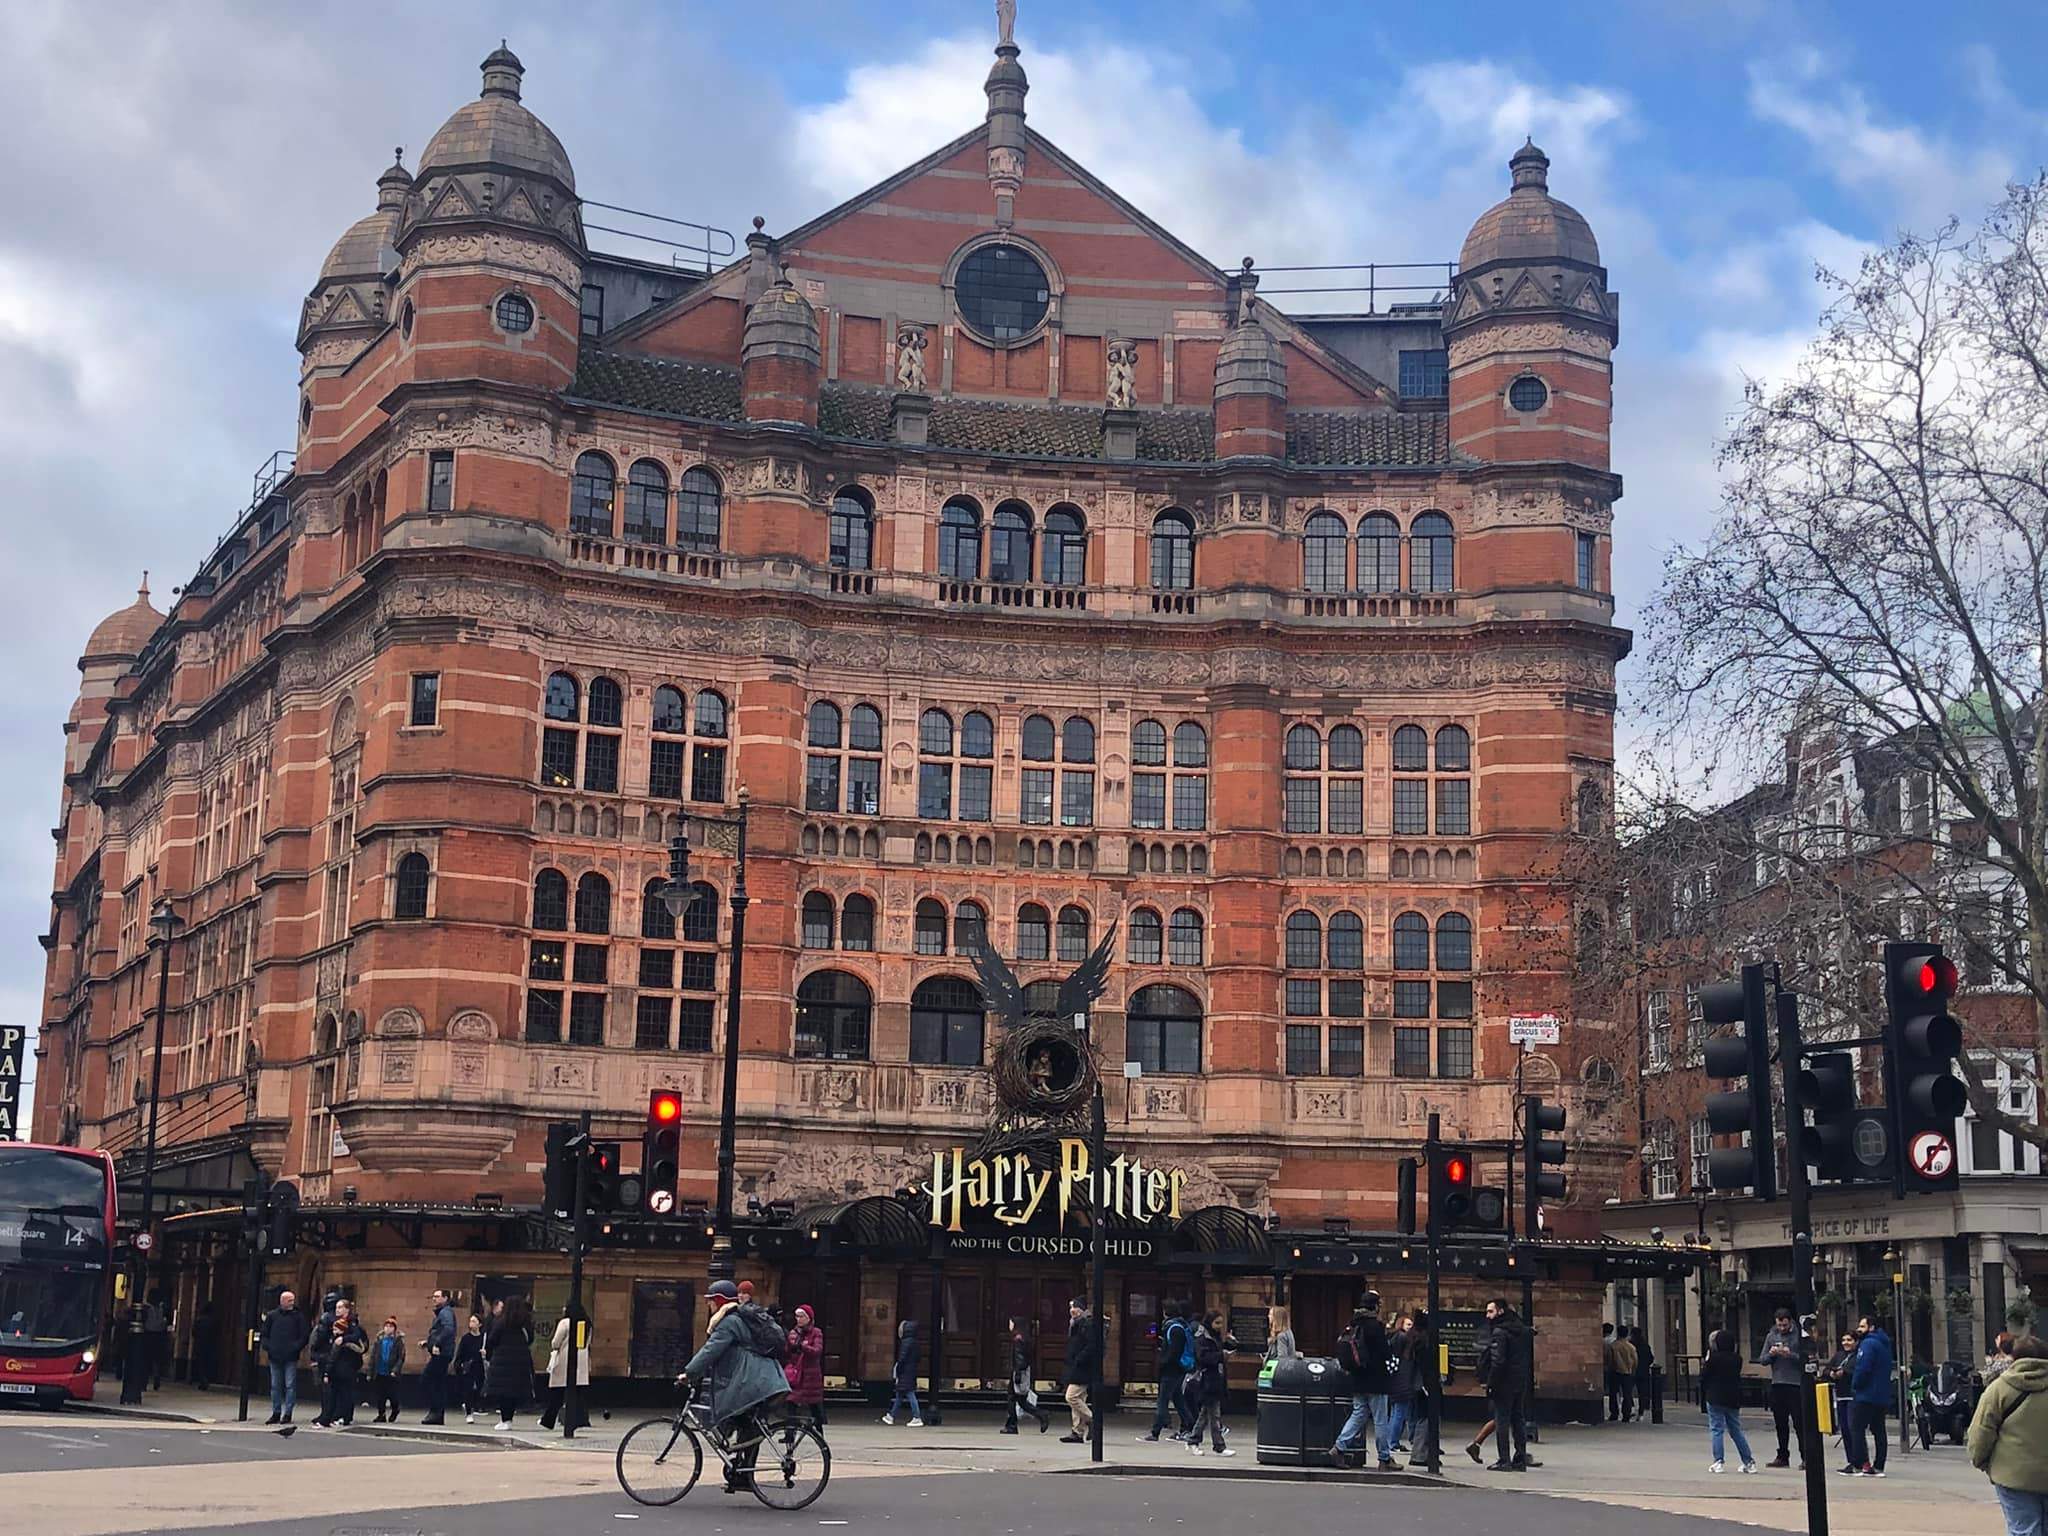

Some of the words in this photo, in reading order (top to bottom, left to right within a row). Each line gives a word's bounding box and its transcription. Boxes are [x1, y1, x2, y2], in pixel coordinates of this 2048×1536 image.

[1513, 1028, 1539, 1036] CIRCUS
[921, 1147, 1053, 1232] Harry
[1058, 1138, 1189, 1234] Potter
[16, 1228, 46, 1240] Square
[64, 1228, 85, 1247] 14
[1810, 1220, 1840, 1239] PICE
[1843, 1219, 1859, 1236] OF
[1863, 1217, 1889, 1235] LIFE
[950, 1238, 977, 1249] AND
[980, 1238, 1001, 1249] THE
[1007, 1236, 1084, 1255] CURSED
